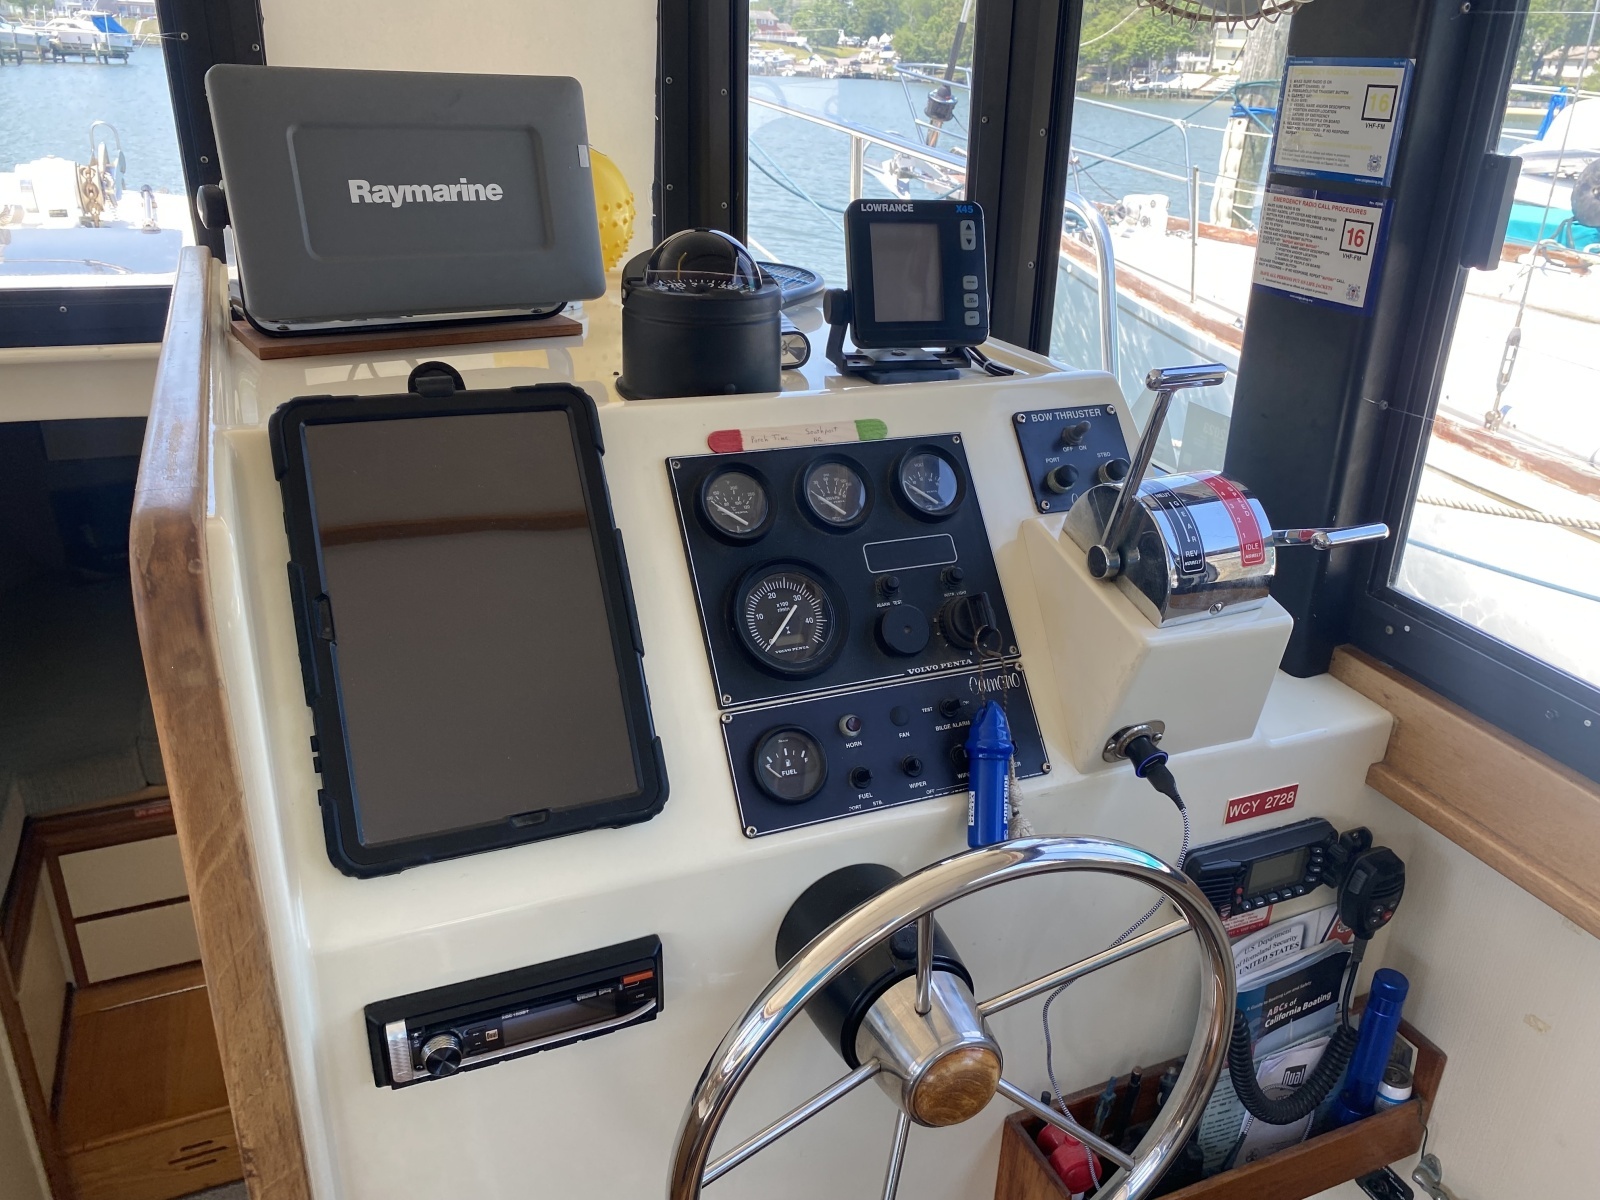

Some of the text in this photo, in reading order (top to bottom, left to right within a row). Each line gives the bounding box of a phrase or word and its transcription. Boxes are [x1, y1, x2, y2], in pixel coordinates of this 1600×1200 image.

[1370, 94, 1389, 112] 16
[348, 178, 503, 208] Raymarine
[861, 204, 973, 214] LOWRANCE X45
[1273, 196, 1301, 205] EMERGENCY
[1332, 205, 1367, 215] PROCEDURES
[1348, 228, 1365, 247] 16
[1031, 408, 1101, 422] BOW THRUSTER
[751, 435, 768, 443] Porch
[805, 426, 838, 435] Southport
[1173, 501, 1197, 542] GEAR
[907, 659, 972, 674] VOLVO PENTA
[909, 781, 927, 789] WIPER
[1229, 791, 1295, 817] WCY 2728
[1243, 944, 1272, 964] Homeland
[1273, 935, 1297, 948] Security
[1245, 945, 1255, 954] U.S.
[1258, 928, 1291, 947] Department
[1240, 942, 1300, 974] UNITED STATES
[1300, 981, 1312, 989] Safety
[1265, 992, 1332, 1028] California Boating
[1267, 998, 1297, 1017] ABCs of
[1283, 1067, 1305, 1086] Dual
